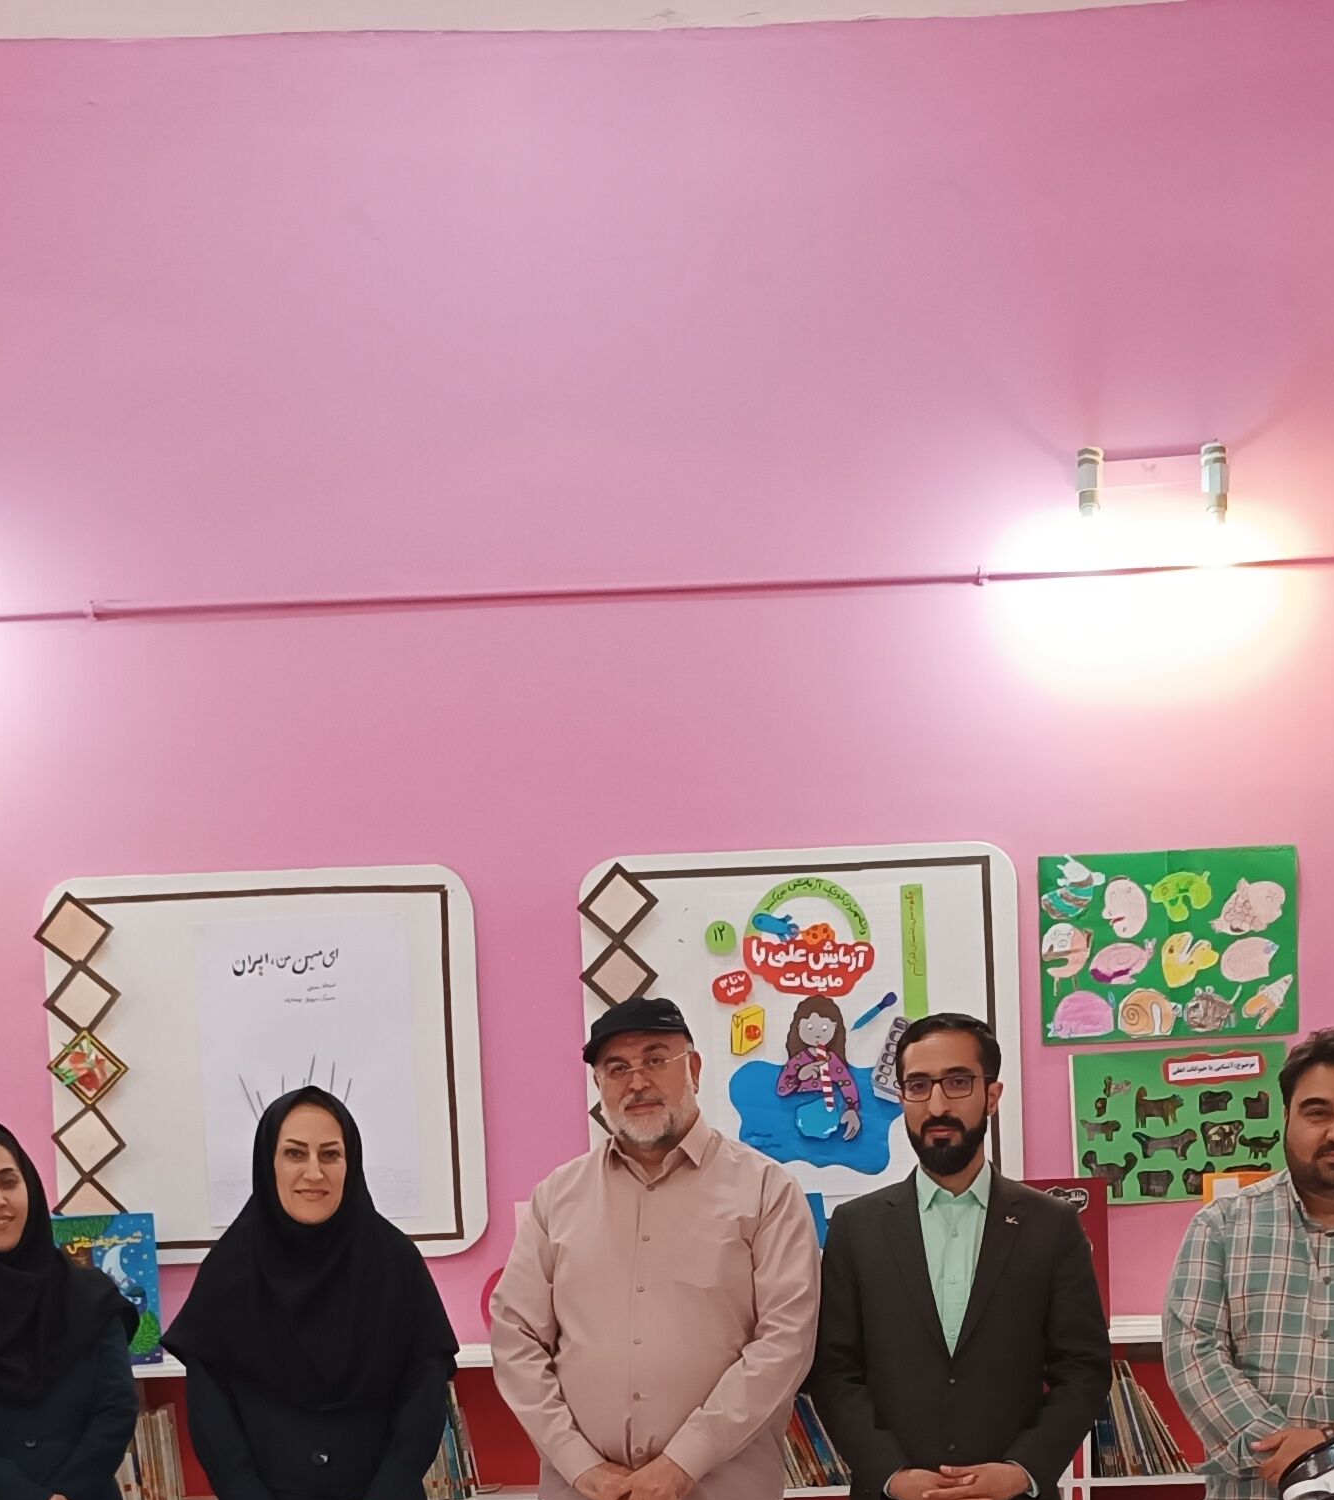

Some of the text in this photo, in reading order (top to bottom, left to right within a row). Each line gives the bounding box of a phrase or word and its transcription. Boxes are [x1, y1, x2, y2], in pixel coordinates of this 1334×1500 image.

[787, 879, 823, 891] آزمایش
[232, 953, 269, 976] ایران
[292, 950, 323, 974] میهن
[322, 948, 339, 968] ای
[752, 940, 868, 972] آزمایش علمی با
[779, 972, 843, 992] مایعات
